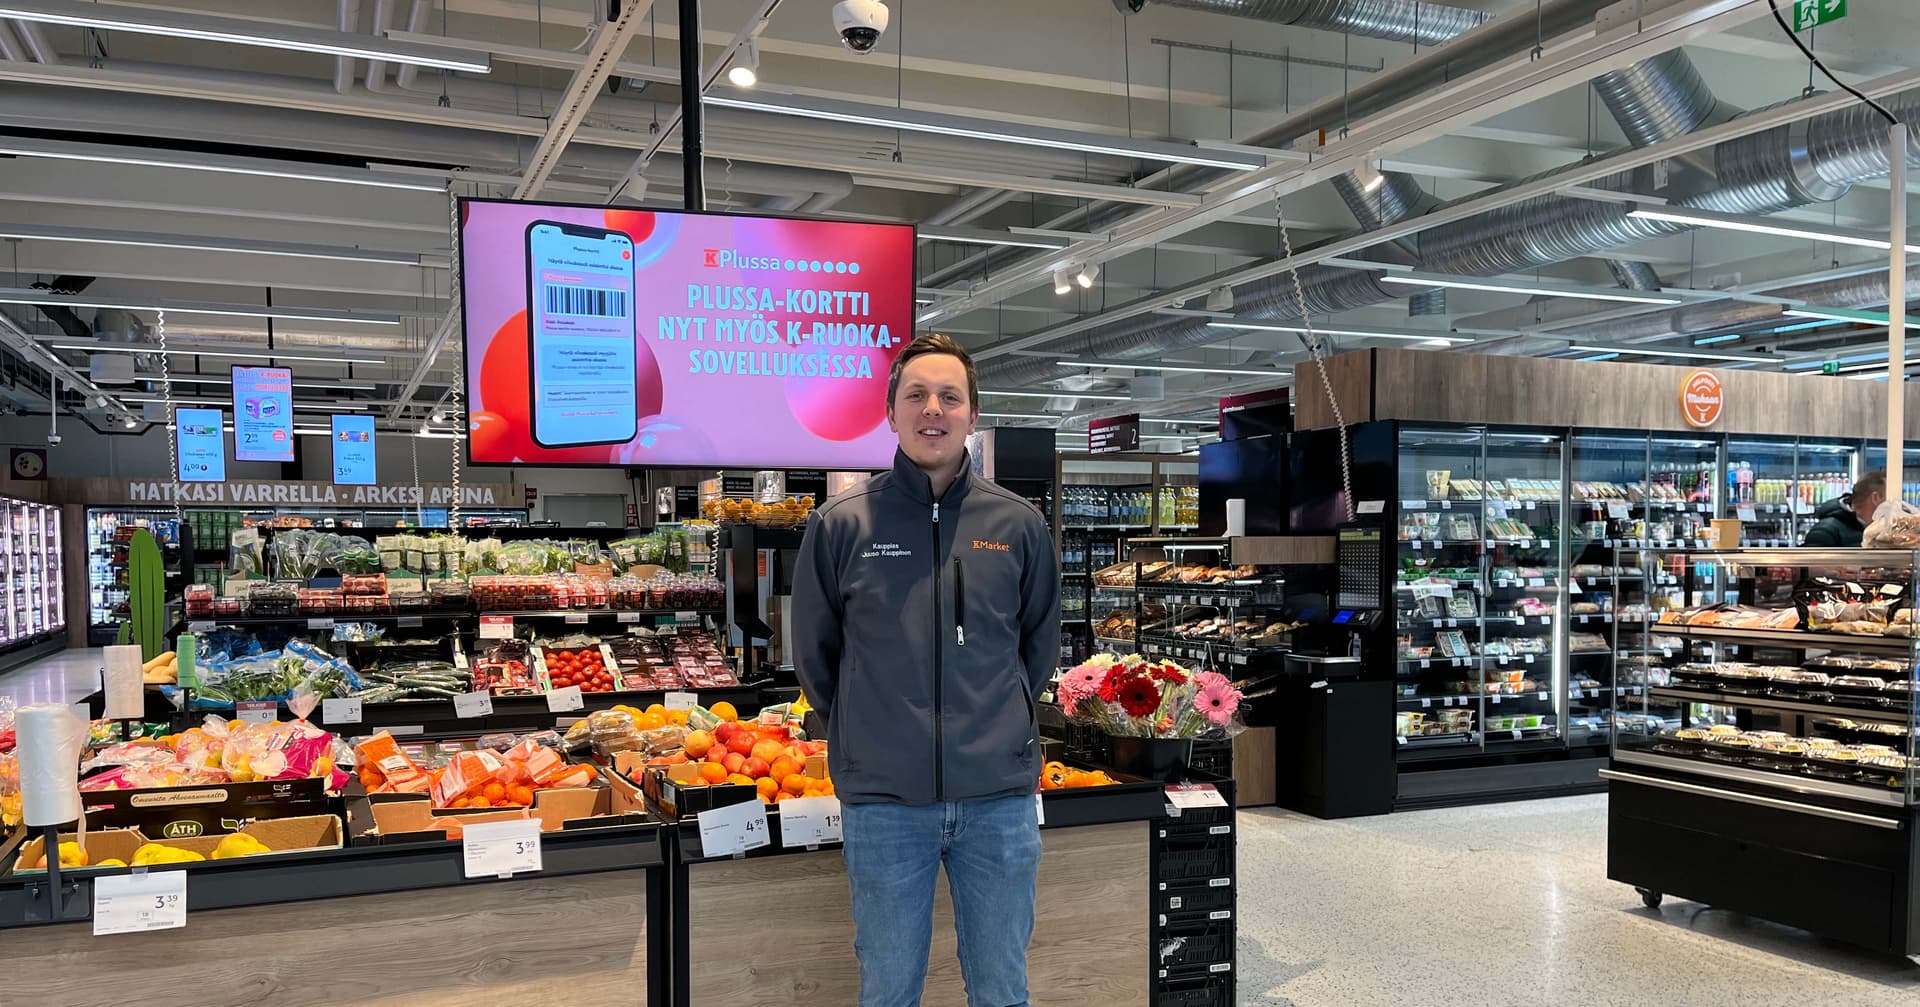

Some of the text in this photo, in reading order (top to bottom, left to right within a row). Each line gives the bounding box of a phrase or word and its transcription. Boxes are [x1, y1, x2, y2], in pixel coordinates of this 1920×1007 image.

[687, 284, 869, 316] PLUSSA-KORTTI
[658, 313, 901, 349] NYT MYÖS K-RUOKA-
[689, 350, 873, 379] SOVELLUKSESSA
[245, 433, 252, 443] 2
[1131, 428, 1137, 445] 2
[337, 467, 344, 476] 3
[130, 482, 225, 501] MATKASI
[229, 483, 337, 503] VARRELLA
[354, 486, 424, 504] ARKESI
[746, 820, 755, 832] 4
[515, 842, 524, 855] 3
[154, 894, 178, 909] 3 39
